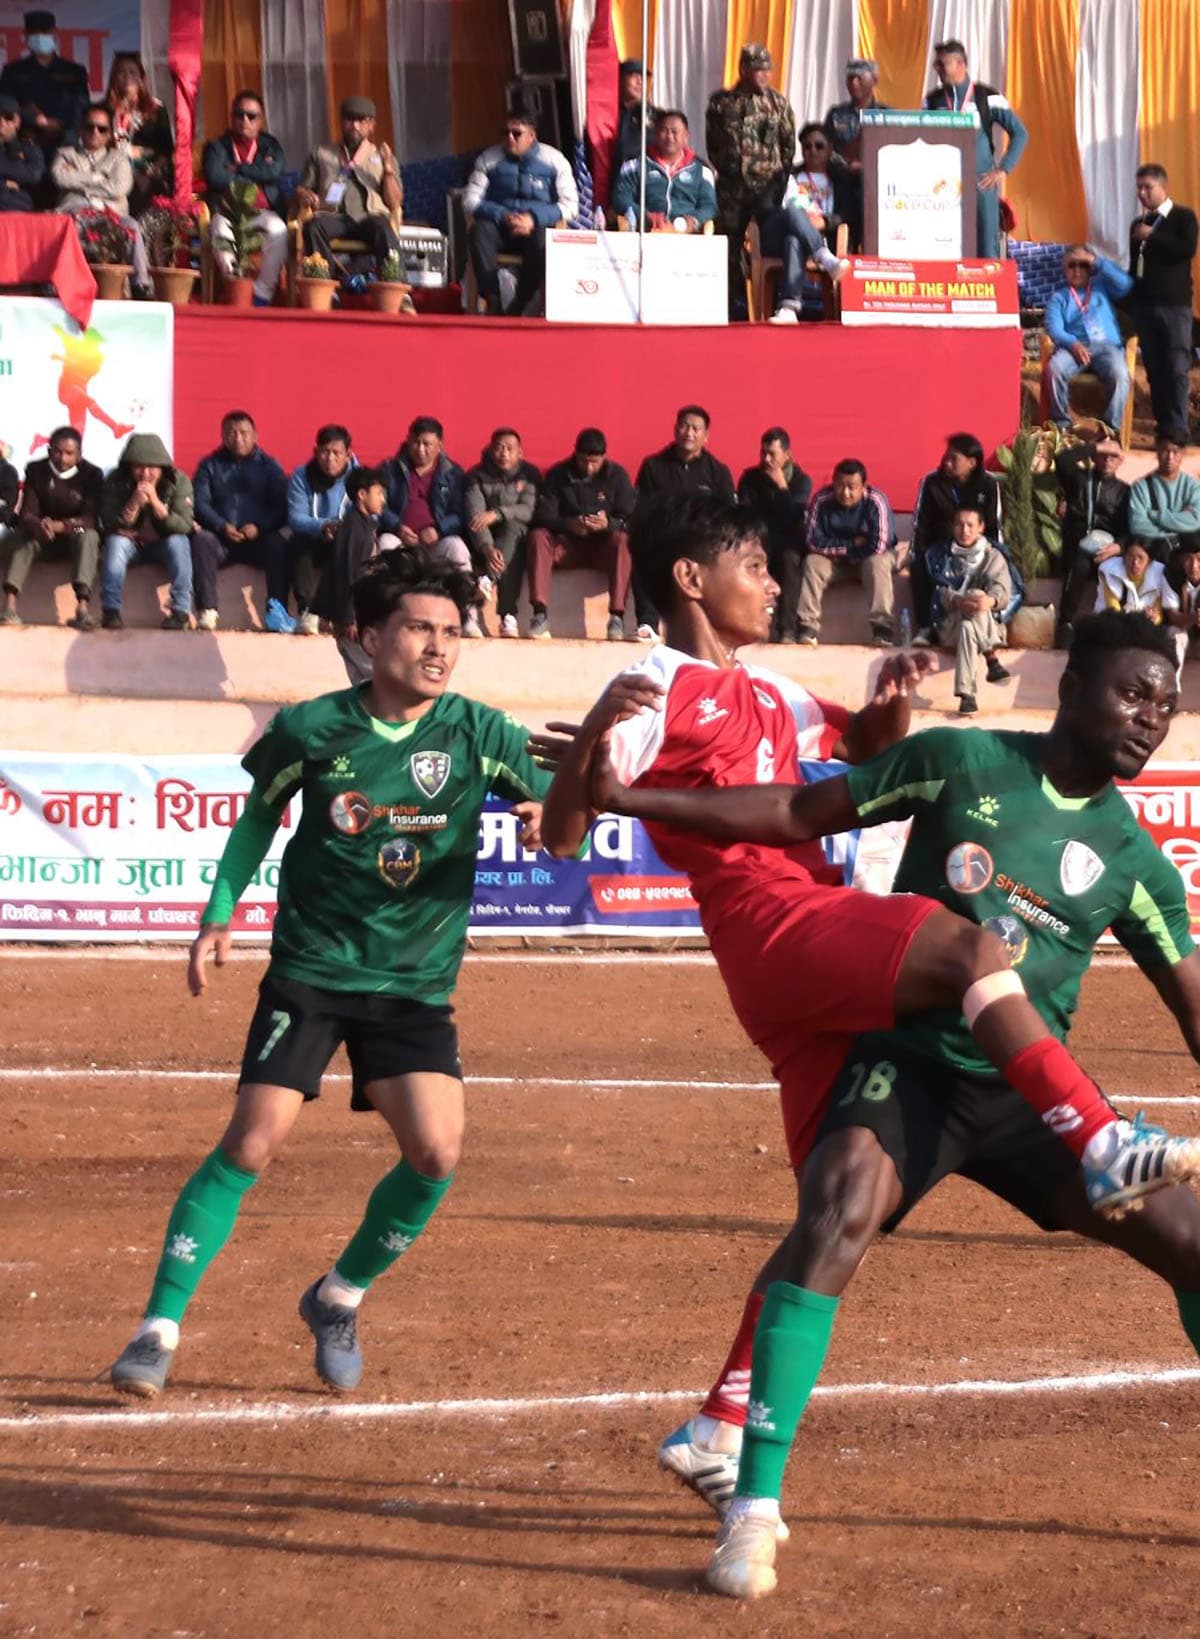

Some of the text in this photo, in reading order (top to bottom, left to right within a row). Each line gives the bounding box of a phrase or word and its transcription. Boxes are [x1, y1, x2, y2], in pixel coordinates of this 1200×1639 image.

[864, 281, 995, 298] MAN OF THE MATCH
[389, 807, 448, 825] Insurance
[965, 808, 1000, 828] KELME
[994, 873, 1051, 909] Shikhar
[1007, 884, 1071, 936] Insurance
[257, 1010, 292, 1063] 7
